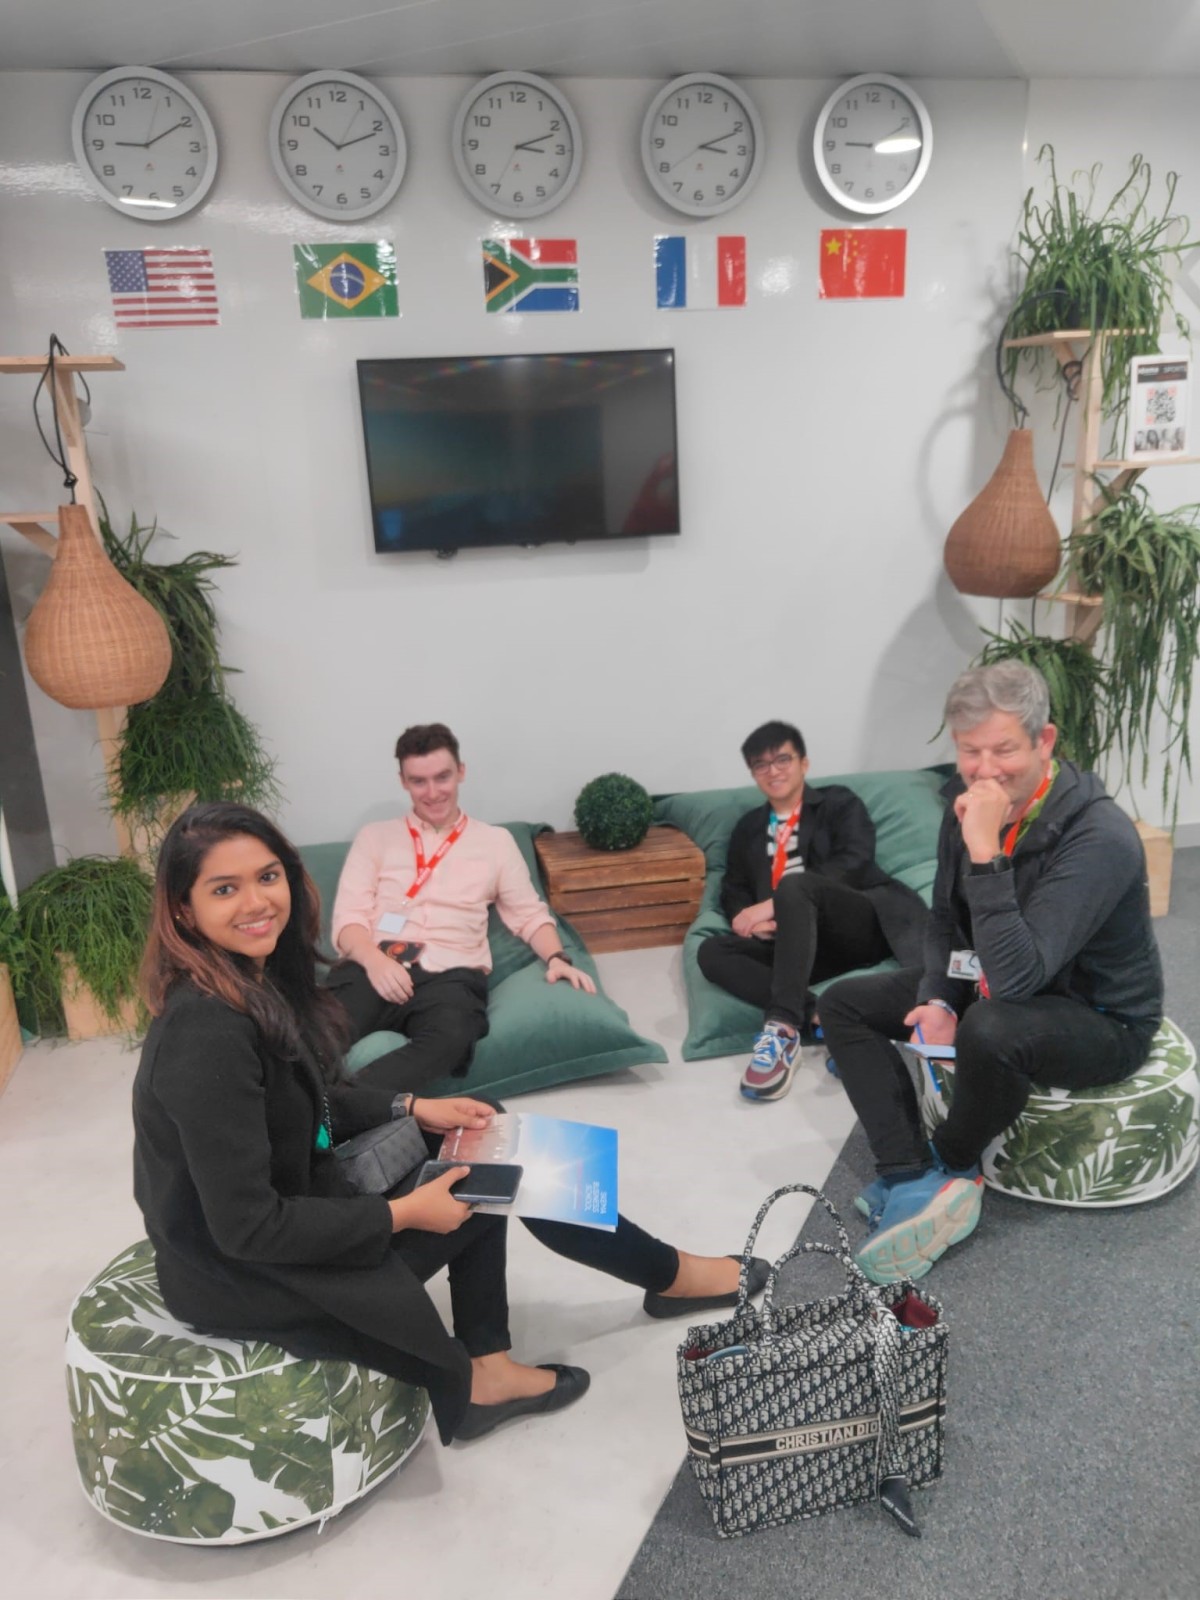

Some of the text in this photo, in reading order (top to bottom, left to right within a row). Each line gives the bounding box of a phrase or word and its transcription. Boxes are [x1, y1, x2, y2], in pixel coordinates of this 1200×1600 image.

[132, 88, 152, 99] 12
[329, 91, 347, 103] 12
[510, 91, 526, 103] 12
[697, 92, 712, 104] 12
[865, 92, 880, 103] 12
[110, 95, 125, 106] 11
[165, 96, 170, 107] 1
[307, 98, 321, 108] 11
[359, 100, 364, 111] 1
[488, 98, 501, 109] 11
[538, 101, 542, 111] 1
[677, 98, 689, 109] 11
[846, 100, 858, 110] 11
[723, 102, 728, 112] 1
[96, 114, 115, 126] 10
[181, 117, 192, 127] 2
[292, 115, 310, 127] 10
[474, 115, 491, 127] 10
[550, 120, 560, 131] 2
[662, 115, 678, 126] 10
[832, 117, 847, 128] 10
[901, 117, 910, 128] 2
[373, 121, 383, 131] 2
[734, 121, 743, 132] 2
[92, 139, 104, 150] 9
[189, 142, 201, 152] 3
[287, 140, 298, 150] 9
[468, 140, 479, 150] 9
[654, 138, 665, 148] 9
[826, 141, 835, 151] 9
[379, 145, 389, 156] 3
[555, 145, 565, 155] 3
[737, 145, 746, 156] 3
[103, 165, 115, 176] 8
[185, 166, 197, 177] 4
[296, 165, 307, 176] 8
[475, 164, 486, 175] 8
[660, 162, 670, 173] 8
[831, 164, 841, 174] 8
[373, 170, 384, 180] 4
[549, 169, 559, 178] 4
[729, 169, 739, 178] 4
[122, 185, 133, 196] 7
[173, 186, 184, 197] 5
[313, 185, 323, 196] 7
[491, 184, 501, 194] 7
[536, 186, 545, 197] 5
[673, 182, 683, 192] 7
[716, 185, 725, 196] 5
[844, 182, 854, 192] 7
[886, 181, 895, 191] 5
[337, 193, 347, 204] 6
[361, 188, 371, 198] 5
[513, 191, 523, 202] 6
[694, 190, 703, 201] 6
[865, 188, 874, 198] 6
[776, 1421, 878, 1450] CHRISTIAN DIO
